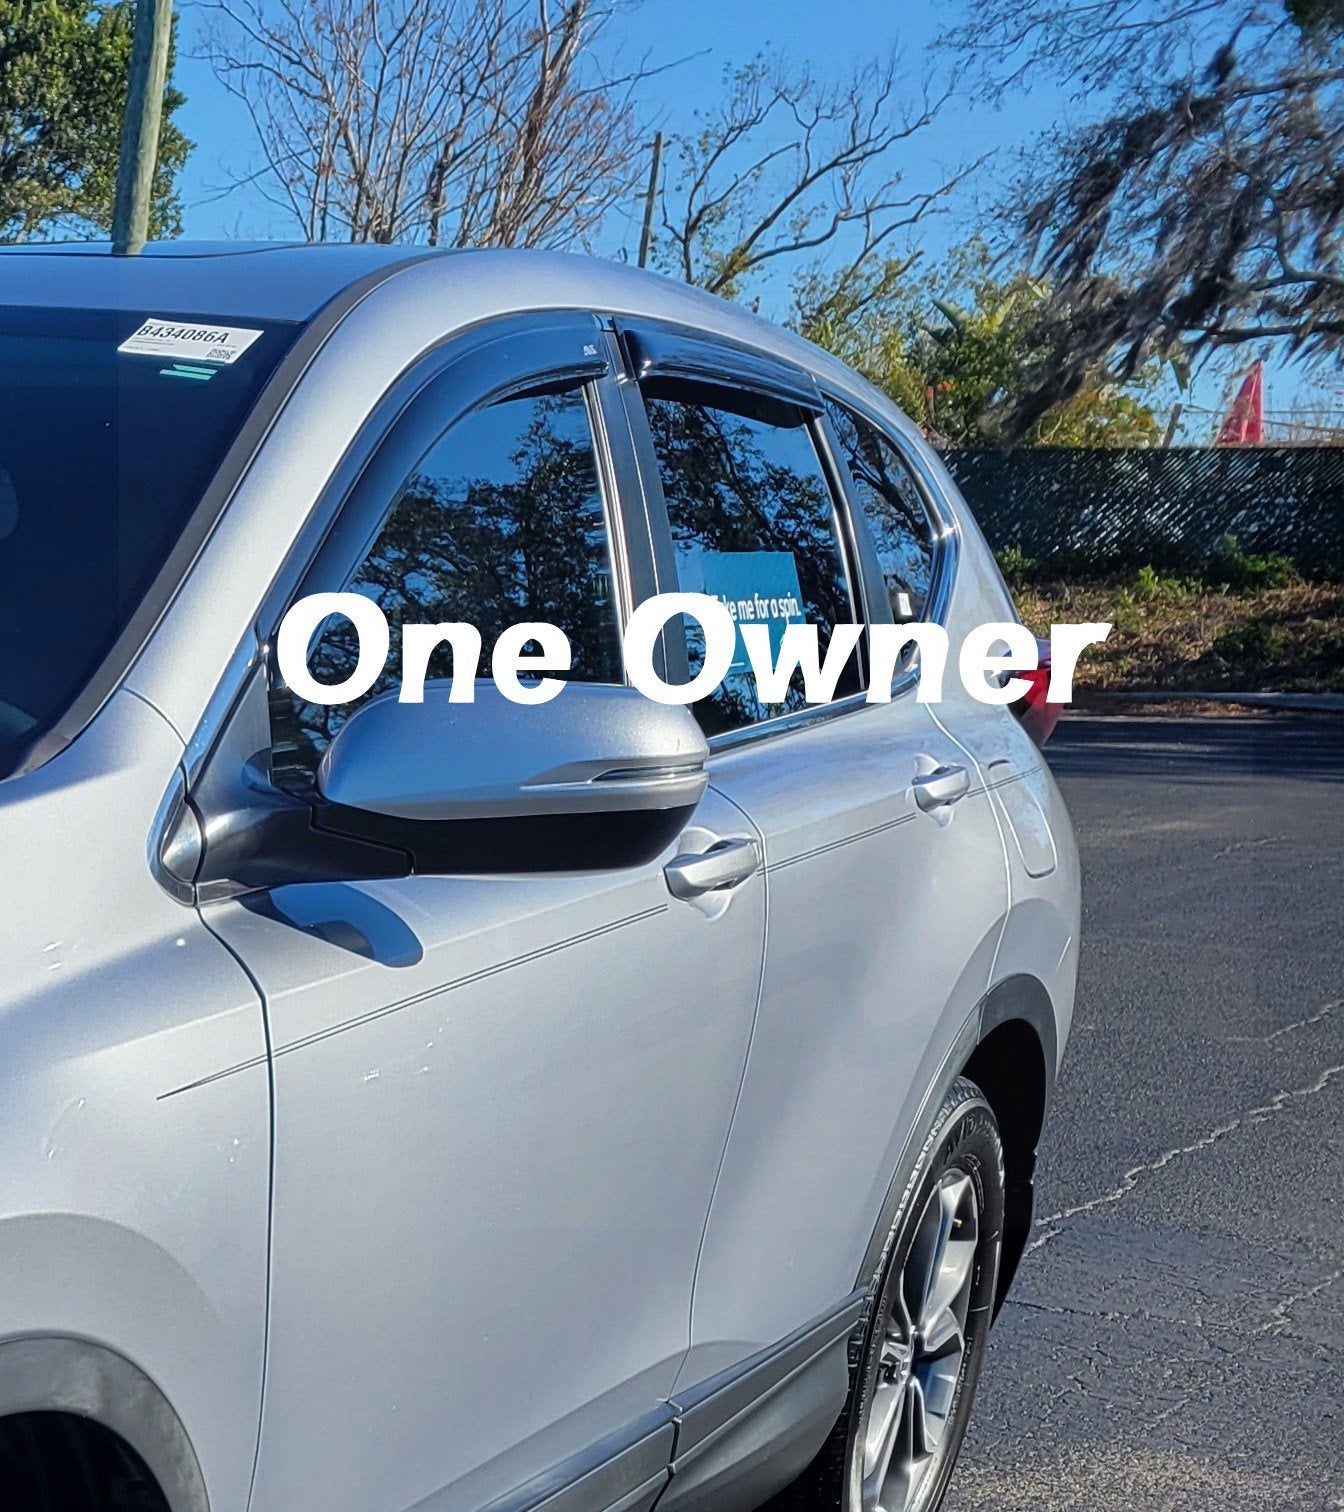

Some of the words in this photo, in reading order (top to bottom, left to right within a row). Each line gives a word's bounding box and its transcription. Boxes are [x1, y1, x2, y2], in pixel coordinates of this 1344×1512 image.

[137, 325, 230, 344] B434086A
[738, 599, 754, 621] me
[754, 592, 770, 620] for
[770, 598, 779, 619] a
